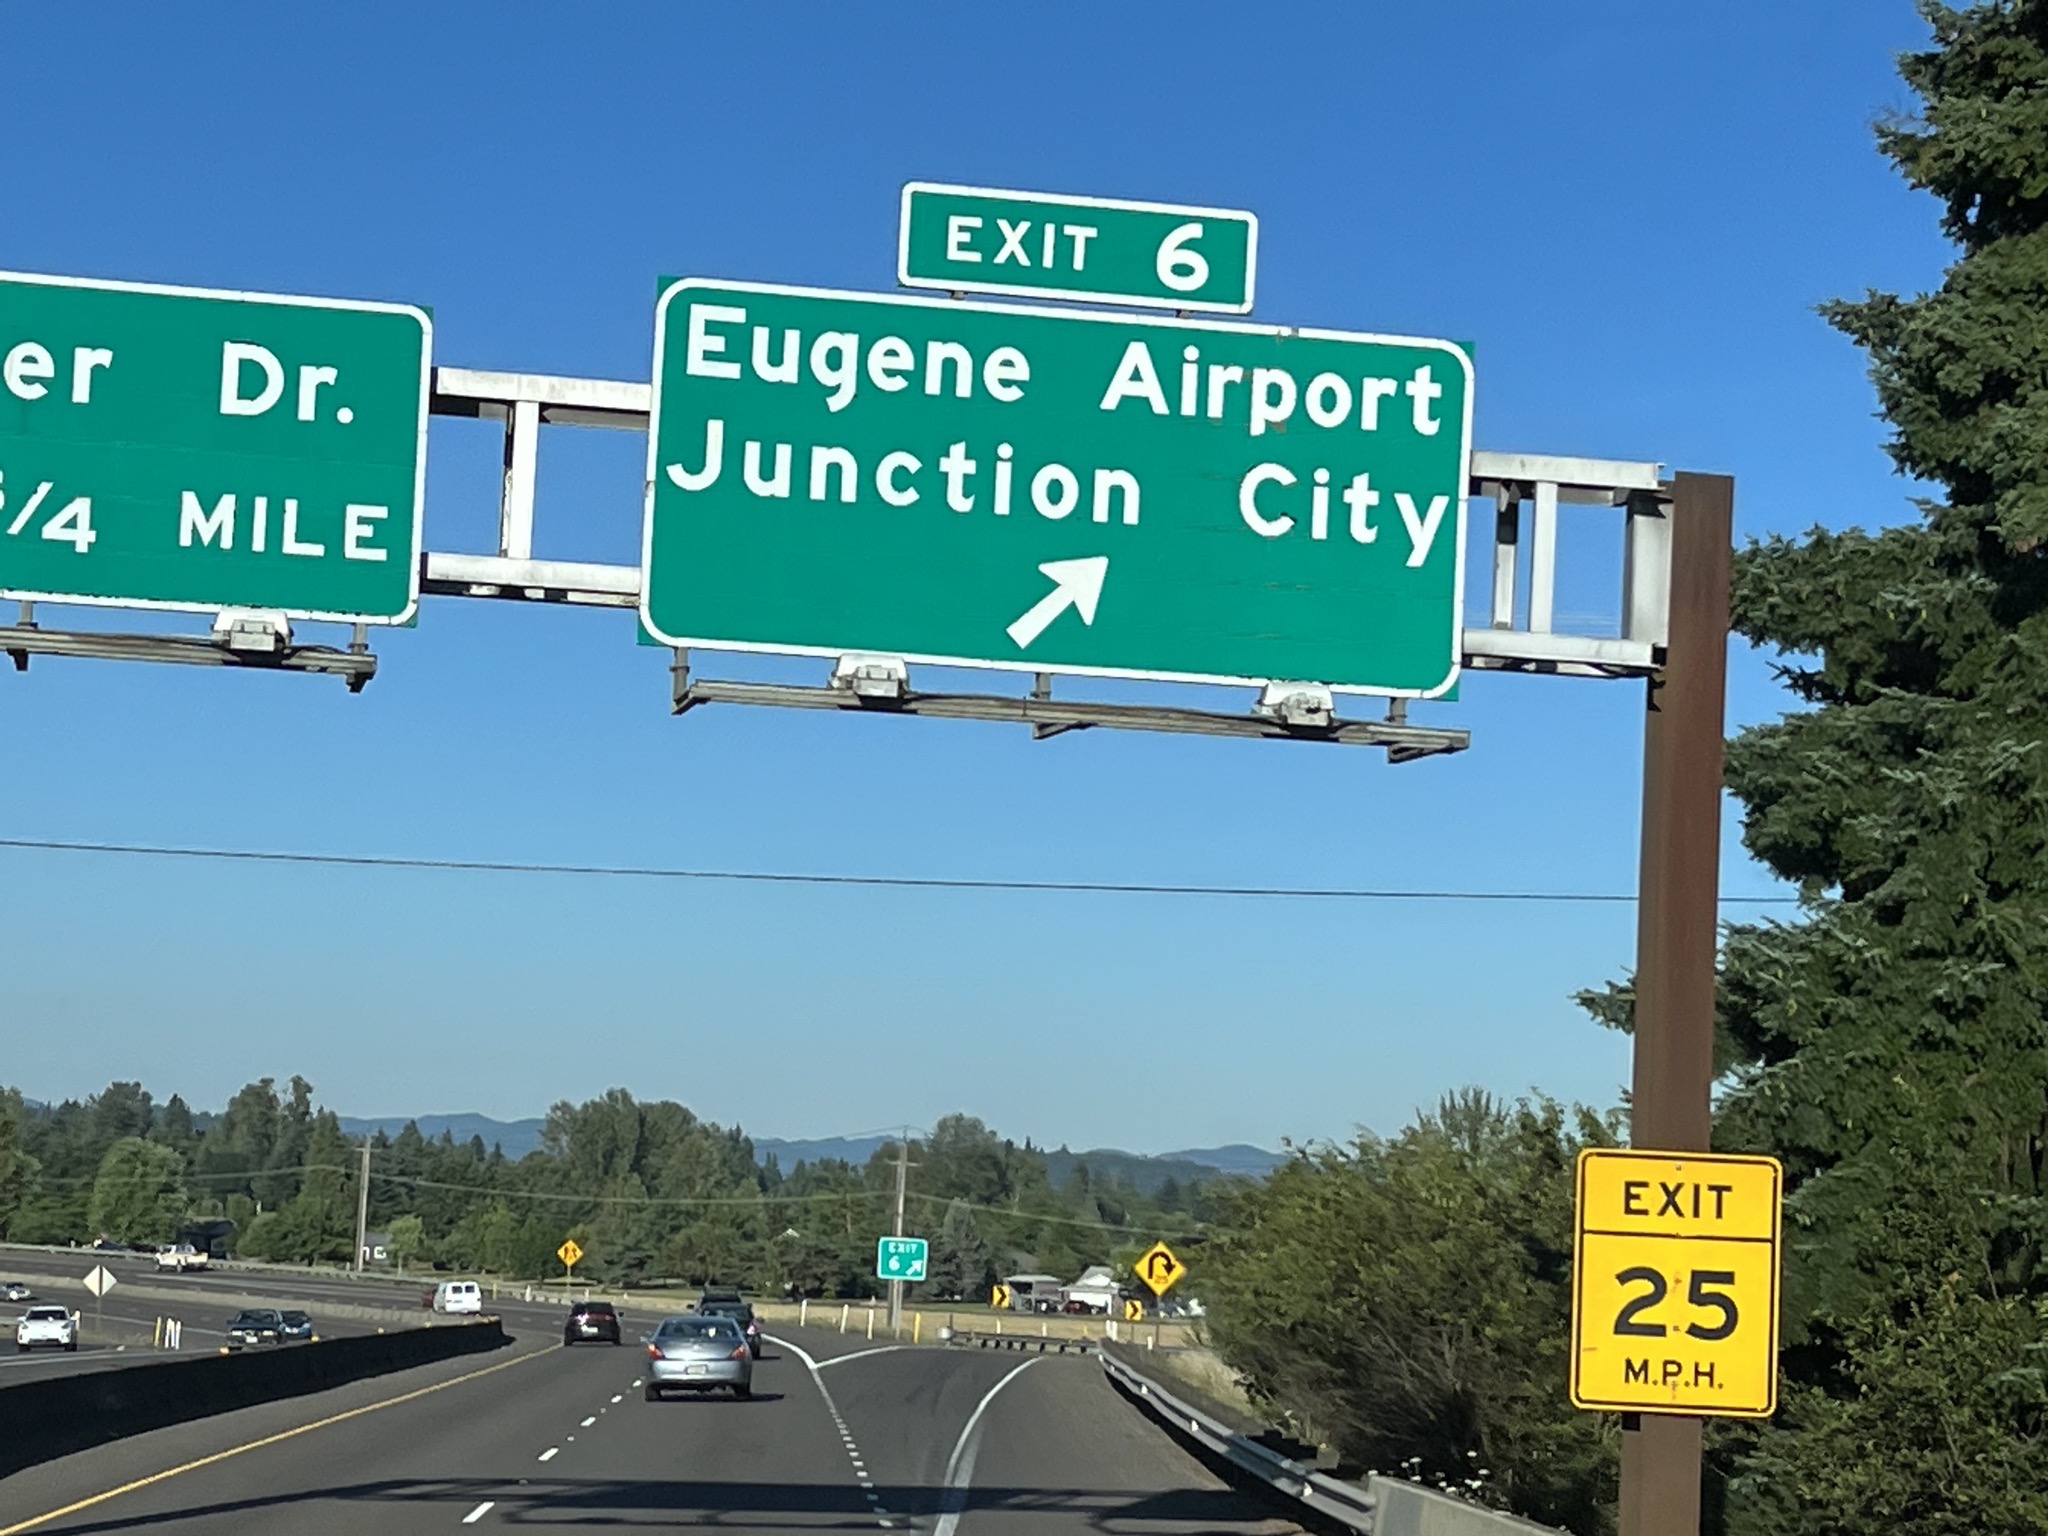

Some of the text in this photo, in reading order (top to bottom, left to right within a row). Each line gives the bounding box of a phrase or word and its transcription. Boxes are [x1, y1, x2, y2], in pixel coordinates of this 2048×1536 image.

[946, 215, 1209, 292] EXIT 6
[3, 341, 354, 425] er Dr.
[686, 303, 1442, 436] Eugene Airport
[0, 470, 390, 562] /4 MILE
[666, 419, 1450, 568] Junction City
[1624, 1180, 1733, 1219] EXIT
[888, 1242, 918, 1254] EXIT
[888, 1255, 900, 1270] 6
[1613, 1266, 1739, 1341] 25
[1624, 1357, 1724, 1389] M.P.H.
